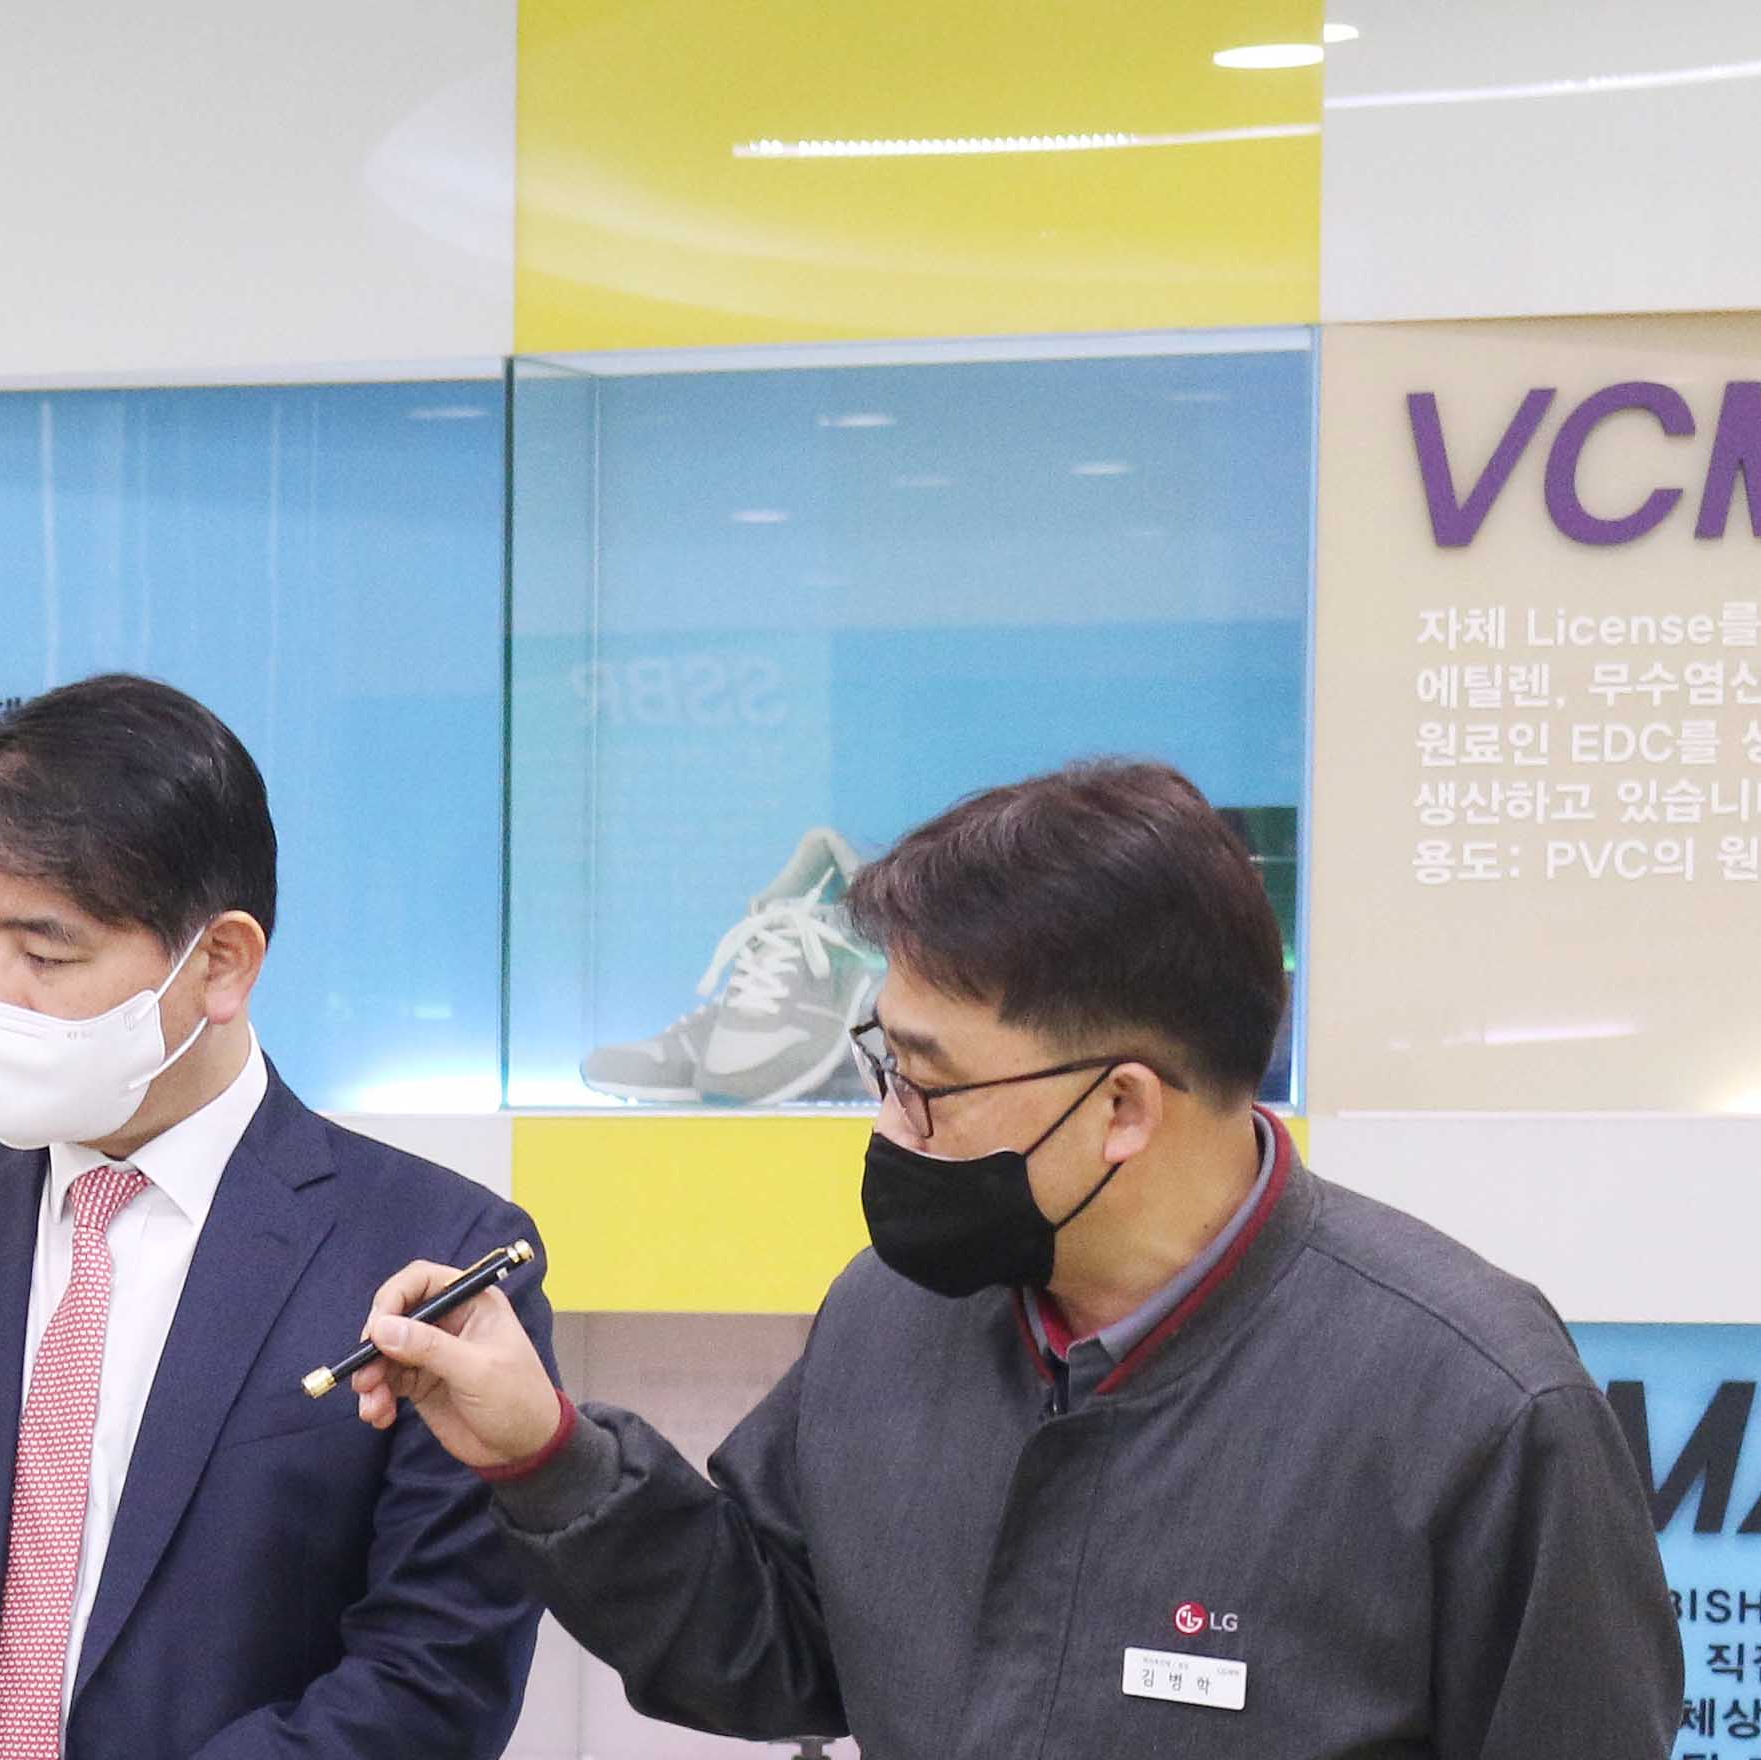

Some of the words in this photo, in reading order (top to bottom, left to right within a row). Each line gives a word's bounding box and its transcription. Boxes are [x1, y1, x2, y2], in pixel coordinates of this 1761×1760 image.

[1415, 605, 1508, 650] 자체
[1526, 601, 1761, 648] License를
[1415, 664, 1567, 708] 에틸렌,
[1414, 721, 1550, 768] 원료인
[1569, 718, 1722, 765] EDC를
[1412, 780, 1597, 827] 생산하고
[1615, 778, 1761, 824] 있습니
[1411, 839, 1521, 885] 용도:
[1544, 837, 1696, 883] PVC의
[1605, 1379, 1761, 1536] M
[1210, 1612, 1239, 1633] LG
